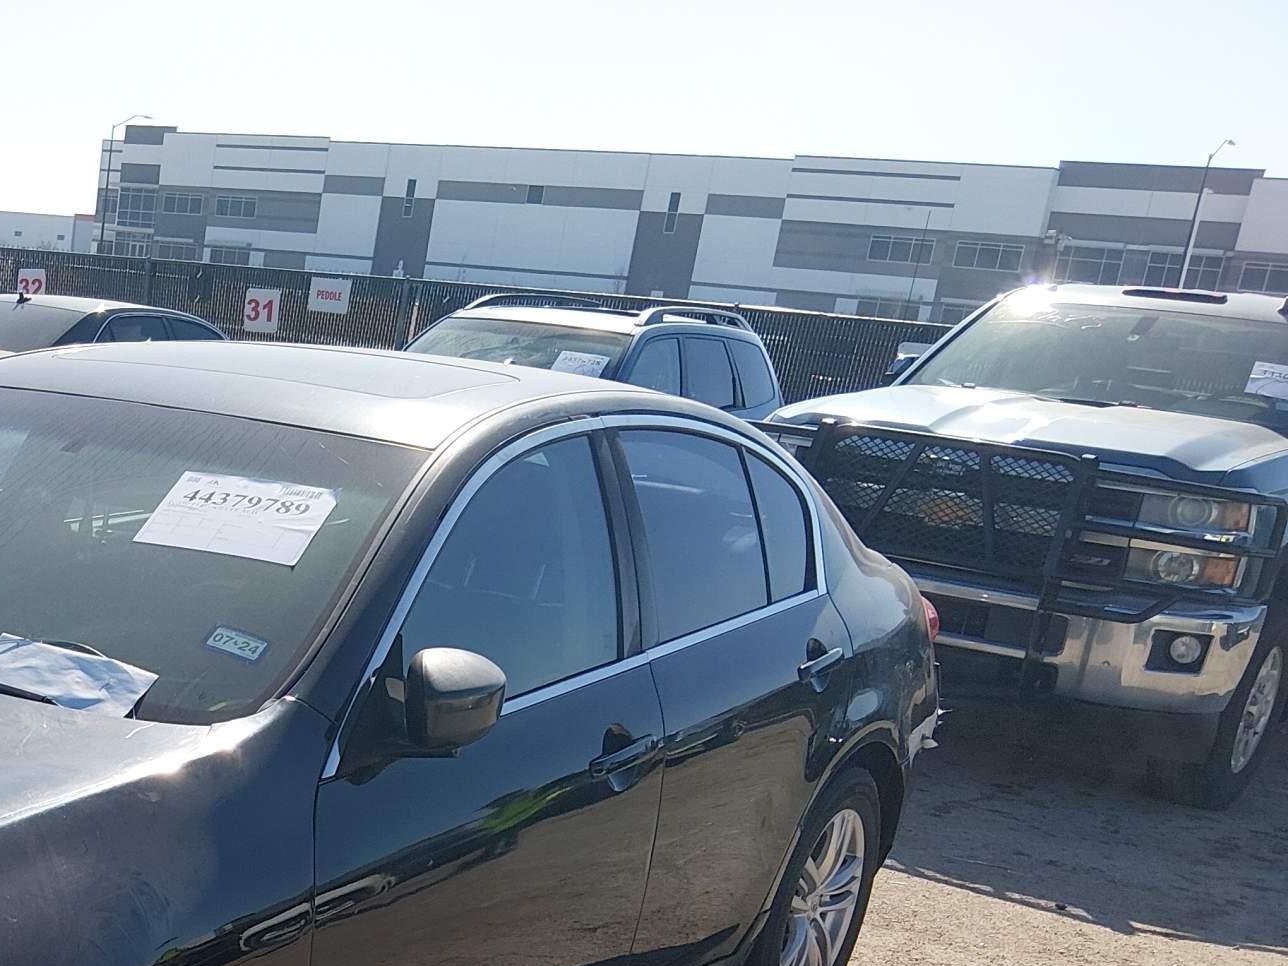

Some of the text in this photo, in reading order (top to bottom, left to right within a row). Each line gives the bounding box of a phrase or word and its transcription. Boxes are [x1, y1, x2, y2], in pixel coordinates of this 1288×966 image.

[316, 289, 343, 302] PEDDLE
[245, 298, 275, 323] 31
[183, 489, 311, 516] 44379789
